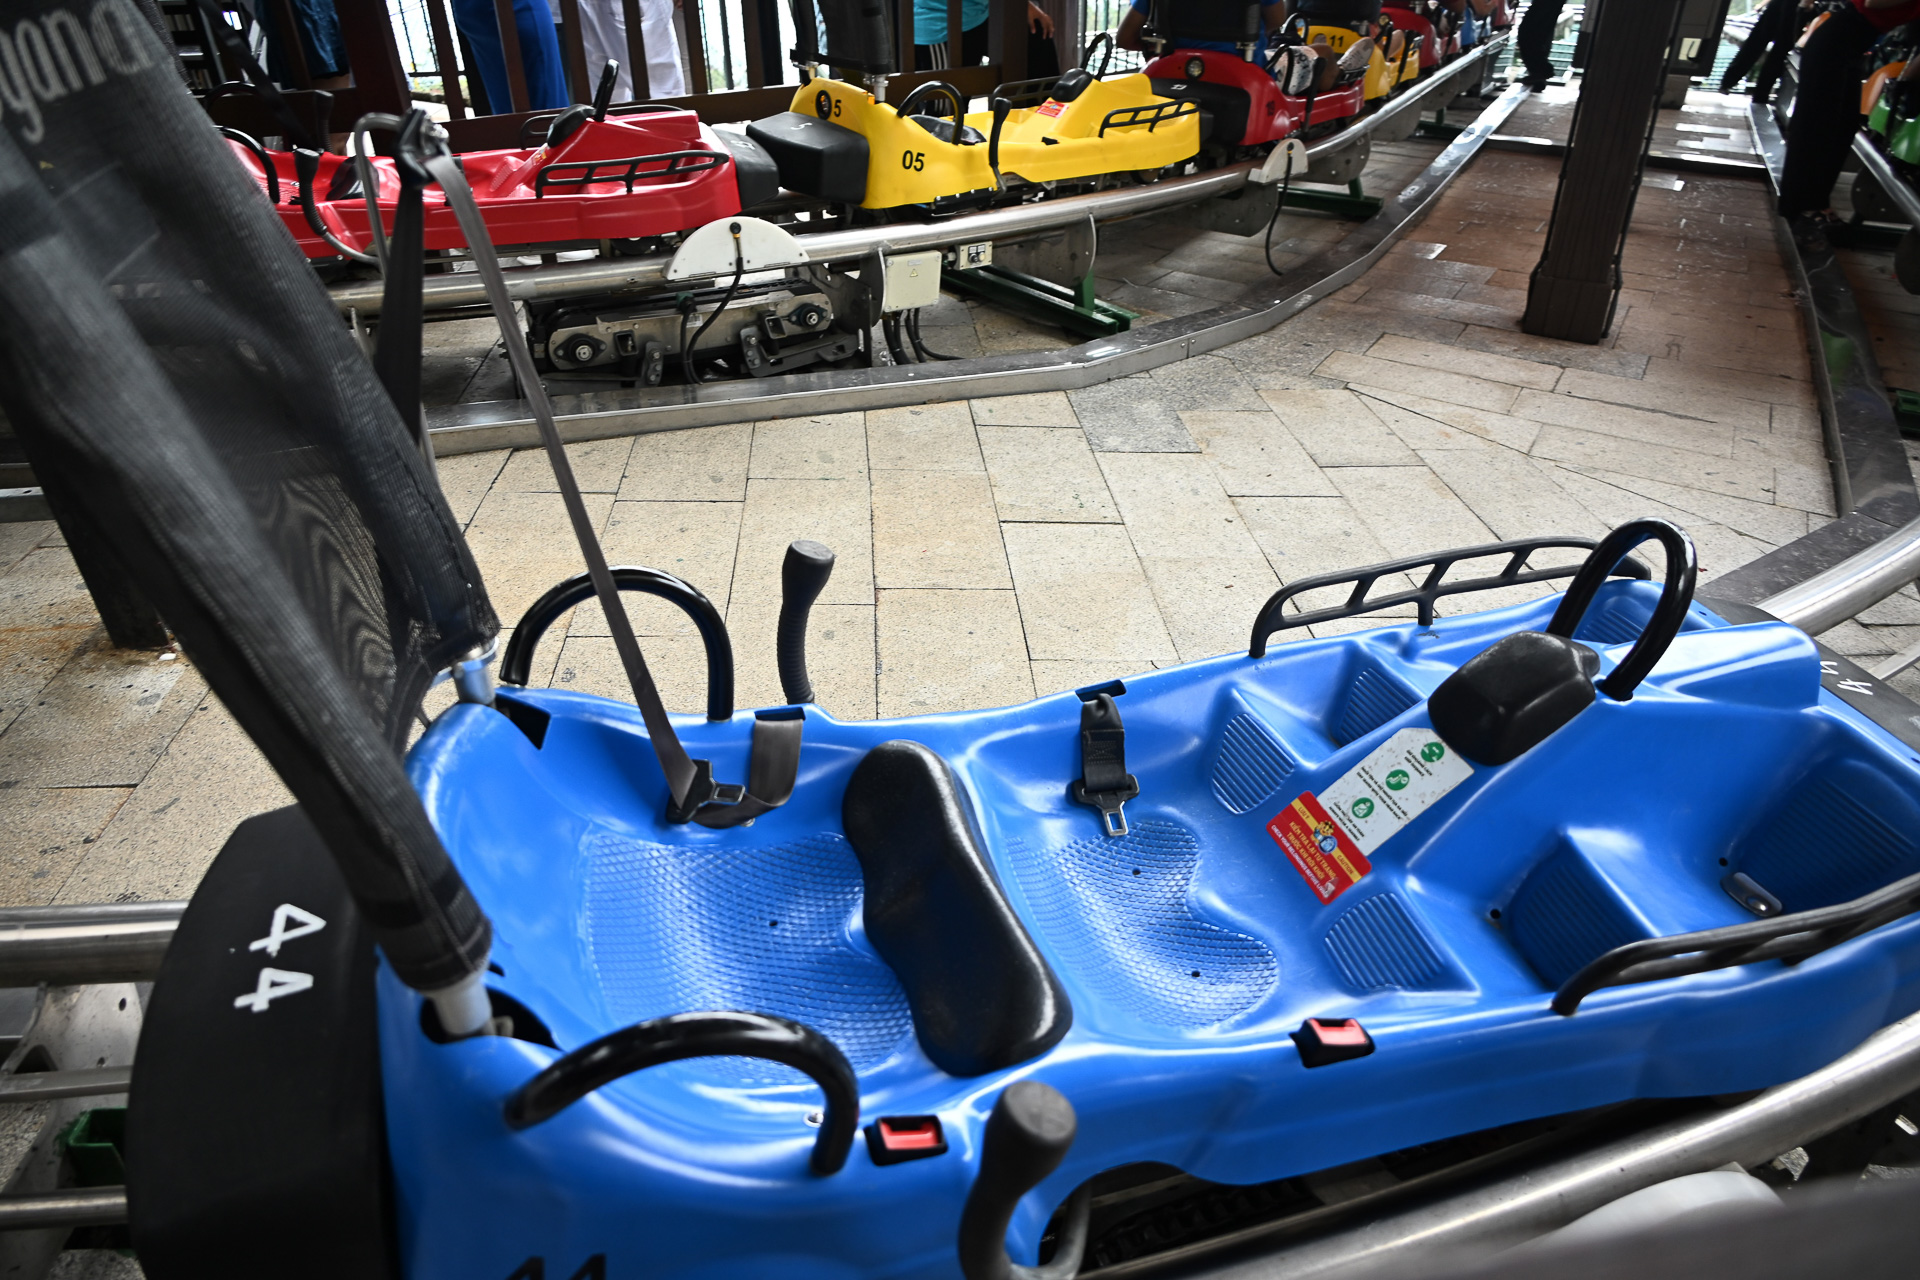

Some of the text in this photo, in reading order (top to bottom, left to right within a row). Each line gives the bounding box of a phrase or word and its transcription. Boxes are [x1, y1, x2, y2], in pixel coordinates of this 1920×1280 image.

[1330, 35, 1344, 47] 11
[903, 150, 925, 172] 05
[1270, 824, 1282, 837] CHECK
[1280, 836, 1290, 847] YOUR
[1287, 845, 1308, 870] BELONGINGS
[1336, 854, 1354, 874] CAUTION
[234, 903, 326, 1013] 44
